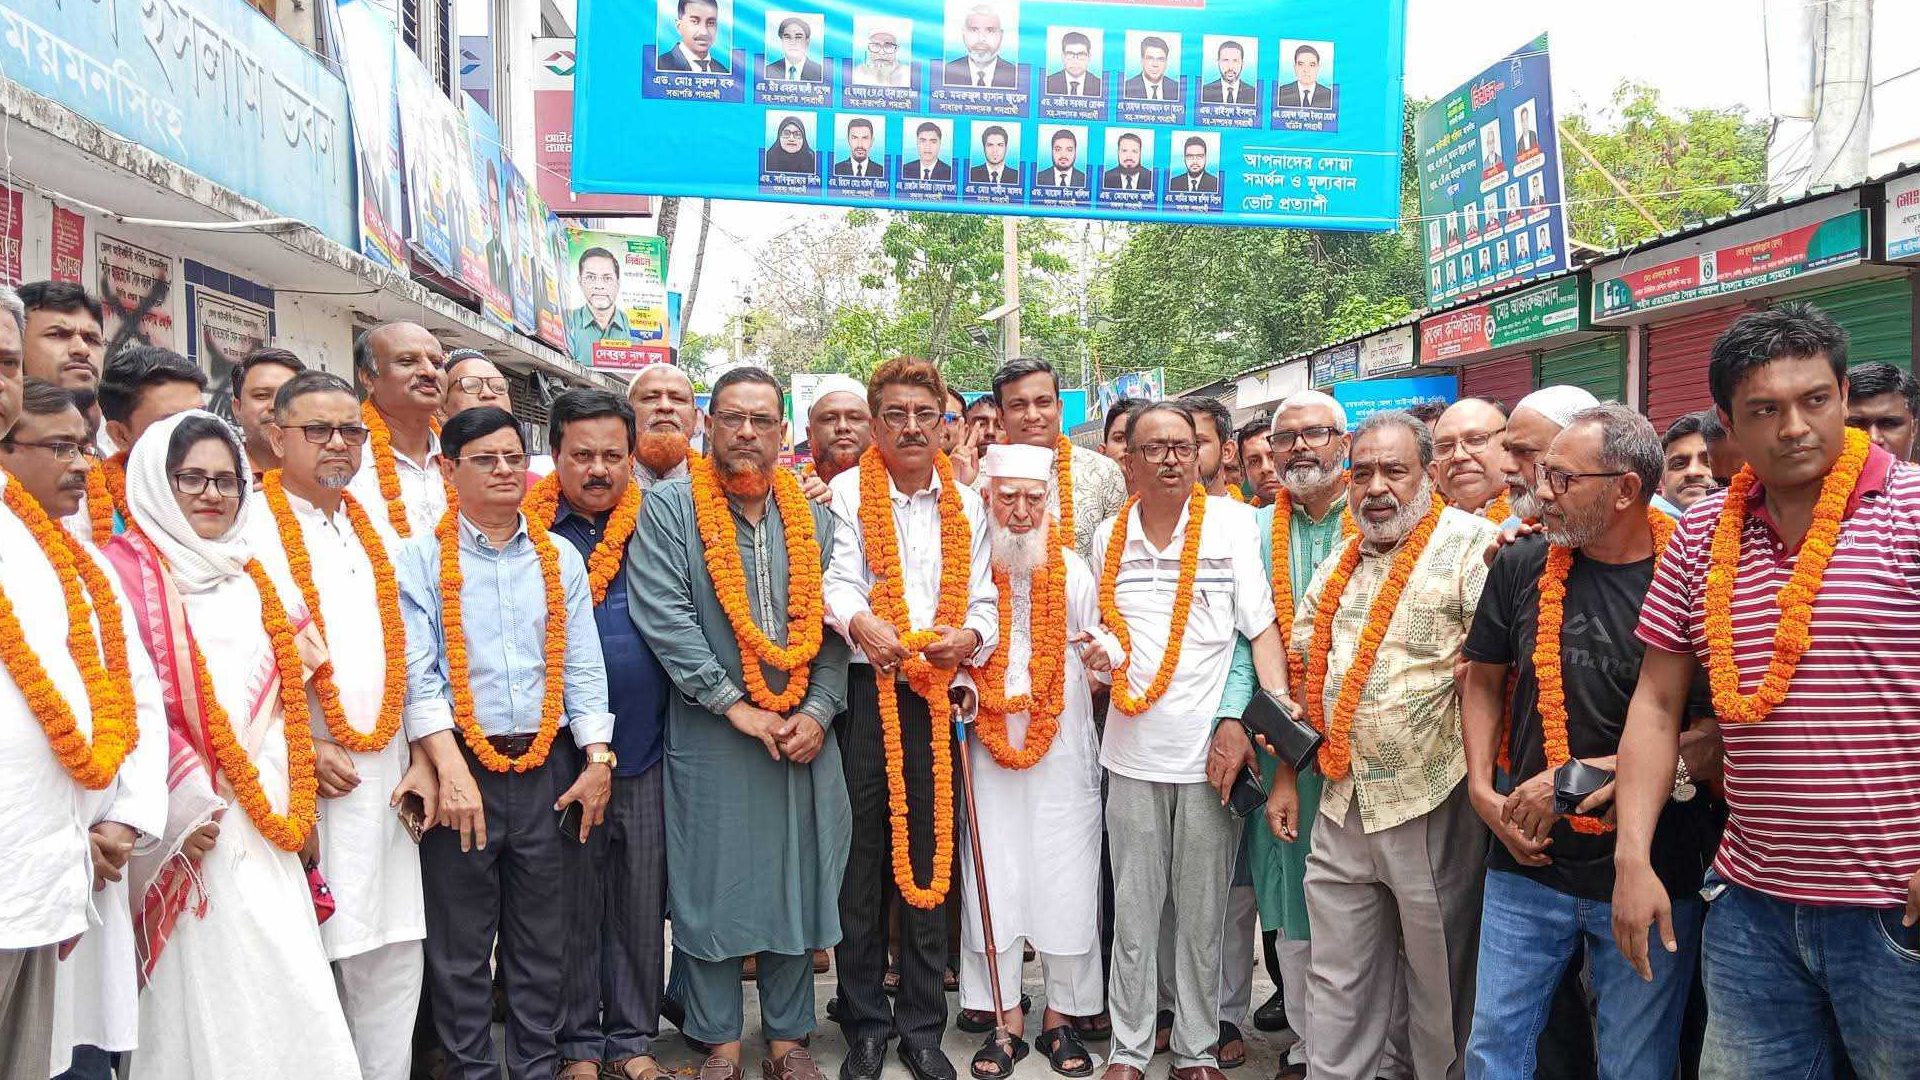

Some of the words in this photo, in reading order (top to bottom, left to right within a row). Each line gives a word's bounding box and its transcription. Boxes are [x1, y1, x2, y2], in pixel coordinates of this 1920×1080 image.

[652, 75, 671, 86] এড.
[674, 77, 692, 87] মোঃ
[666, 88, 693, 98] সভাপতি
[1243, 154, 1313, 171] আপনাদের
[1318, 157, 1353, 172] দোয়া
[1243, 170, 1285, 188] সমর্থন
[1291, 176, 1301, 188] ও
[1307, 175, 1358, 195] মূল্যবান
[1242, 194, 1274, 210] ভোট
[1279, 194, 1329, 213] প্রত্যাশী
